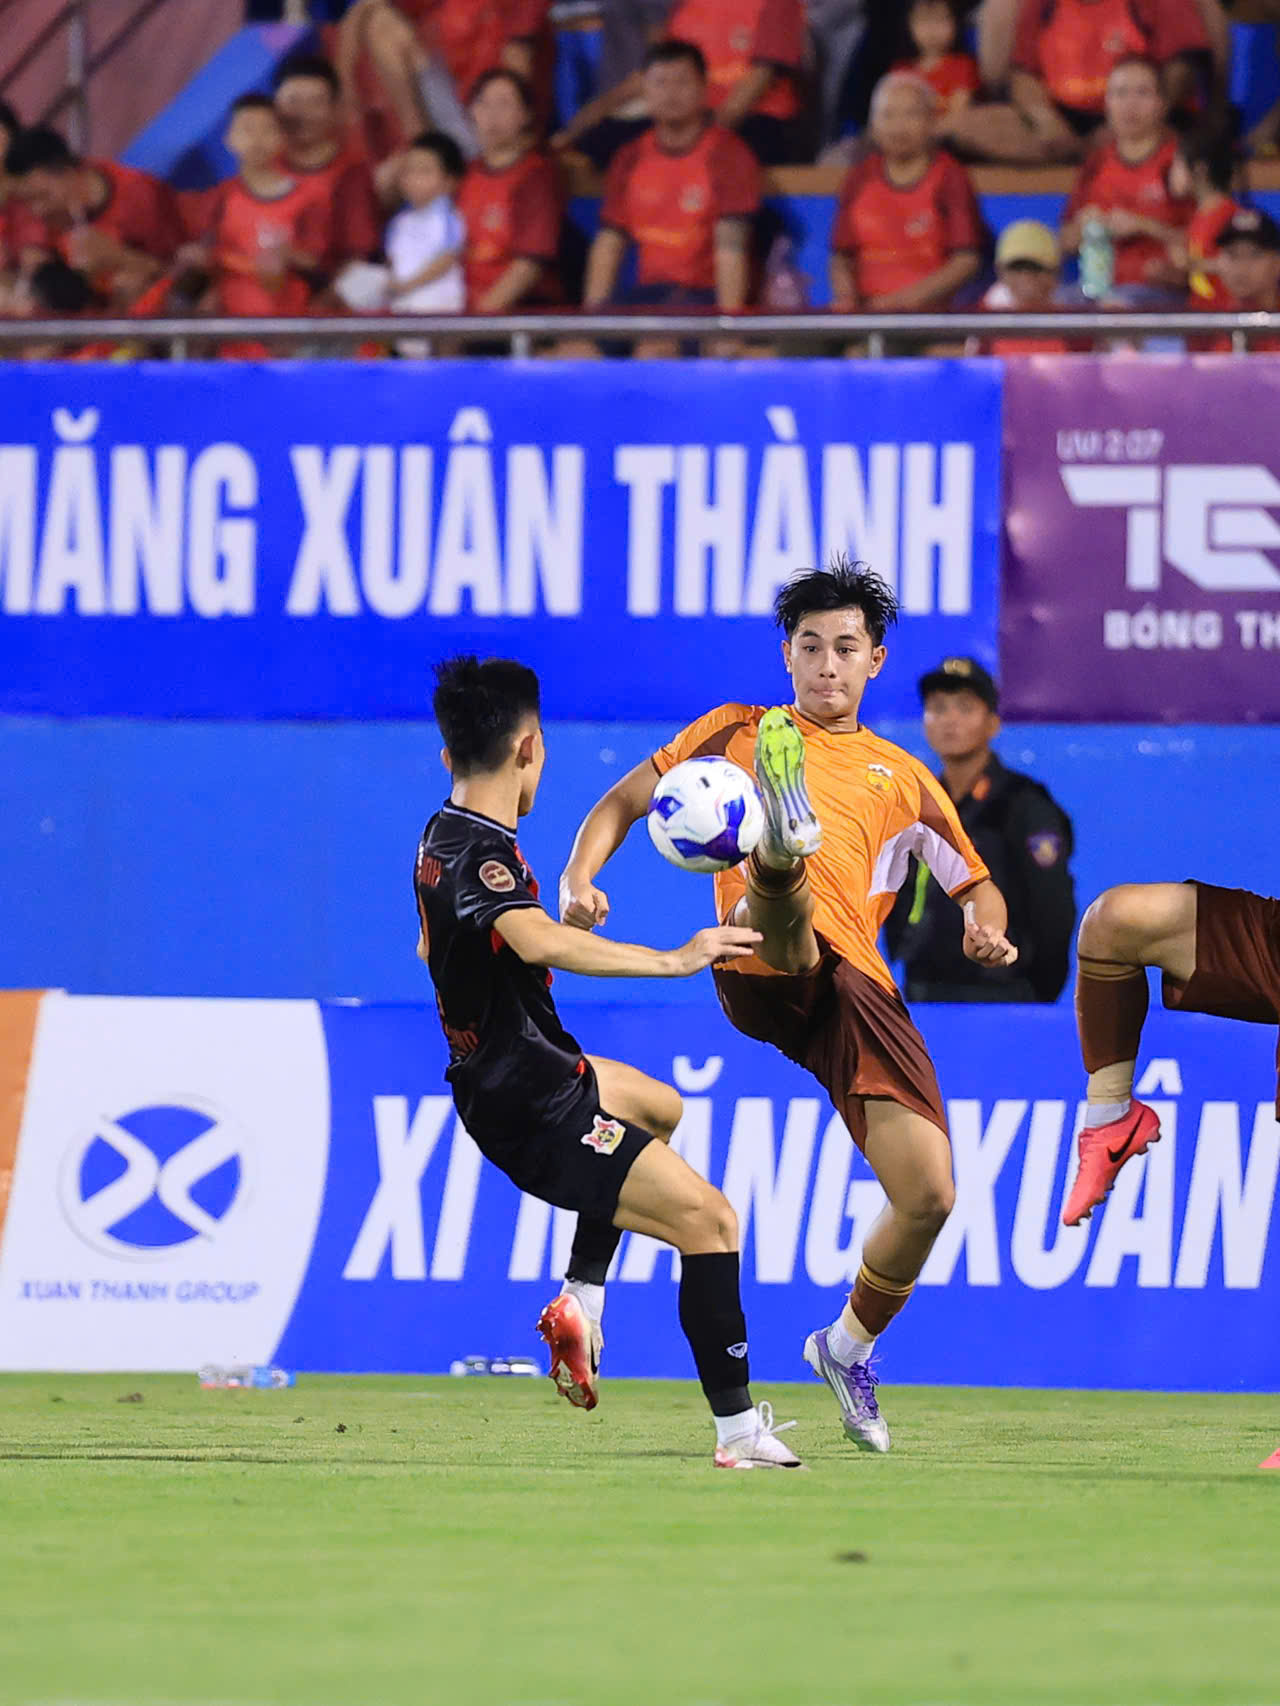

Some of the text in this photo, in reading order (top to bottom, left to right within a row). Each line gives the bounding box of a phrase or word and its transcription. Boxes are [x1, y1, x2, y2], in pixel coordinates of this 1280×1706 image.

[286, 407, 585, 617] XUÂN
[614, 405, 974, 617] THÀNH
[1103, 603, 1222, 649] BÓNG
[342, 1095, 484, 1281] XI
[509, 1056, 892, 1285] ĂNG
[21, 1280, 261, 1302] XUAN THANH GROUP
